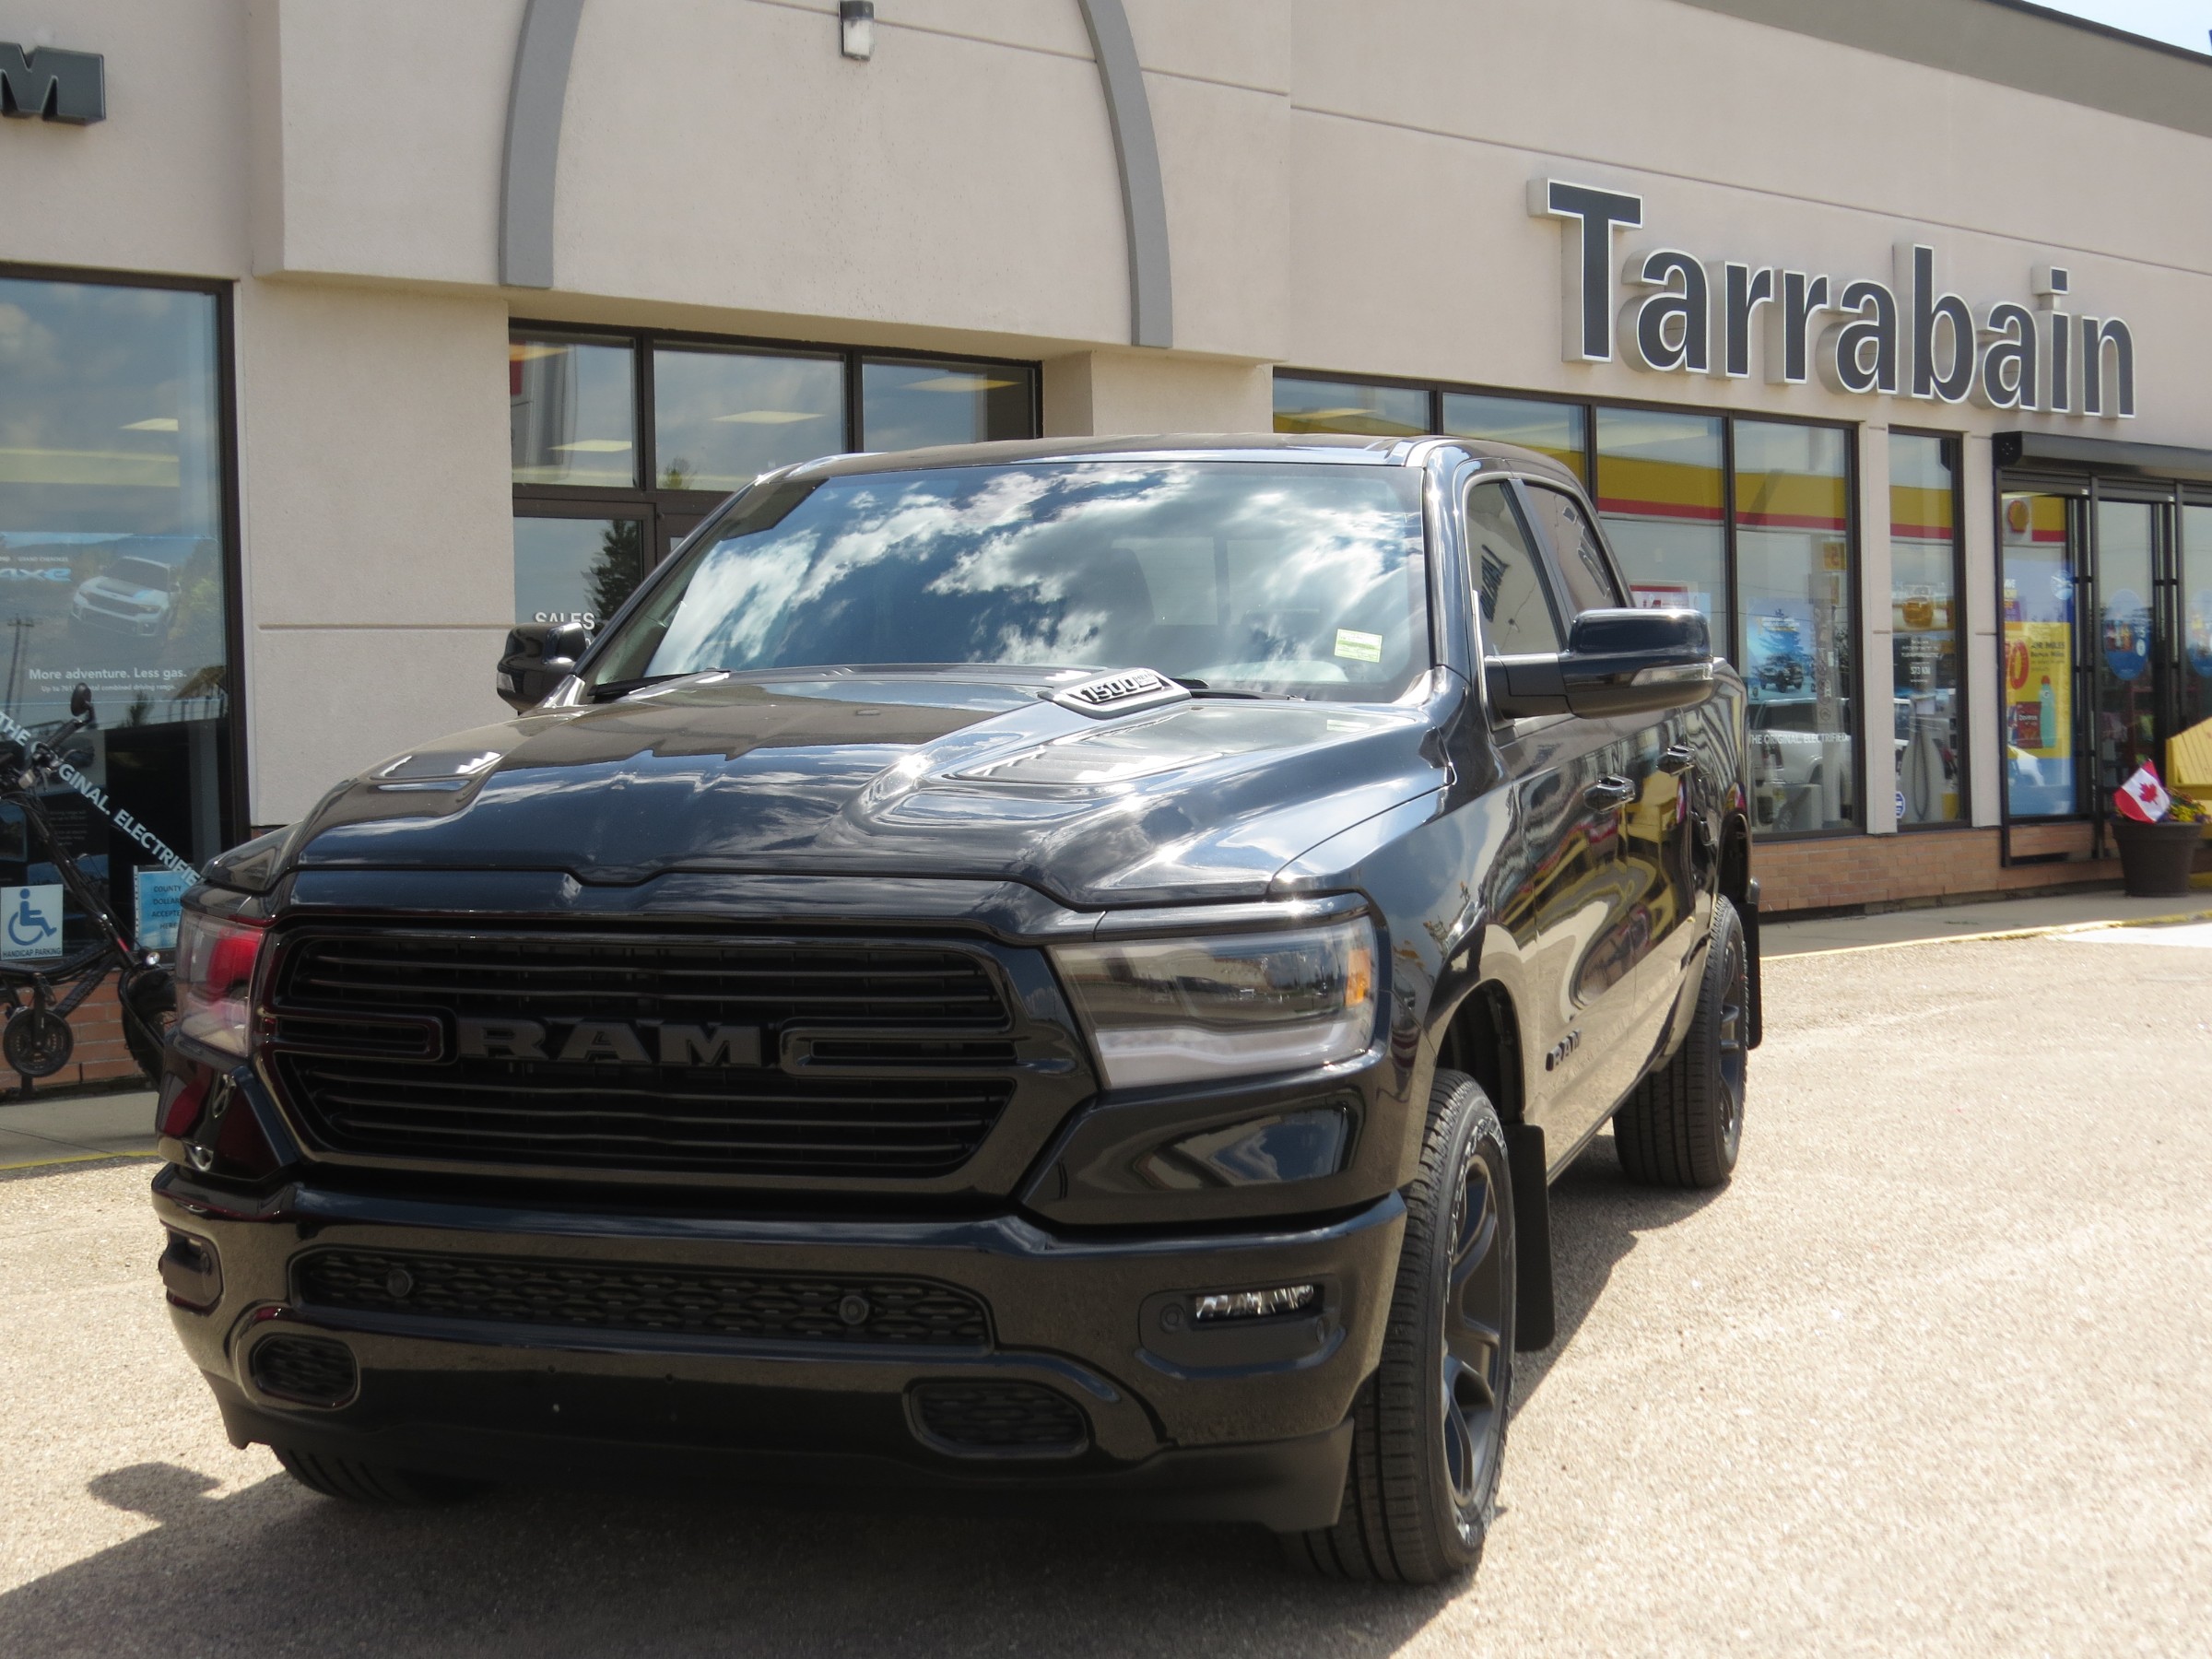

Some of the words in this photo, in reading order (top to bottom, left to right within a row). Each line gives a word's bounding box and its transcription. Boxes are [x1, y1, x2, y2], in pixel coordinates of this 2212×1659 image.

[1528, 177, 2136, 420] Tarrabain
[29, 669, 62, 680] More
[65, 667, 130, 679] adventure.
[134, 667, 159, 678] Less
[163, 669, 187, 681] gas.
[1080, 677, 1137, 701] 1500
[113, 808, 201, 887] ELECTRIFIE
[153, 885, 182, 893] COUNTY
[3, 949, 34, 958] HANDICAP
[35, 947, 62, 956] PARKING
[459, 1017, 762, 1067] RAM
